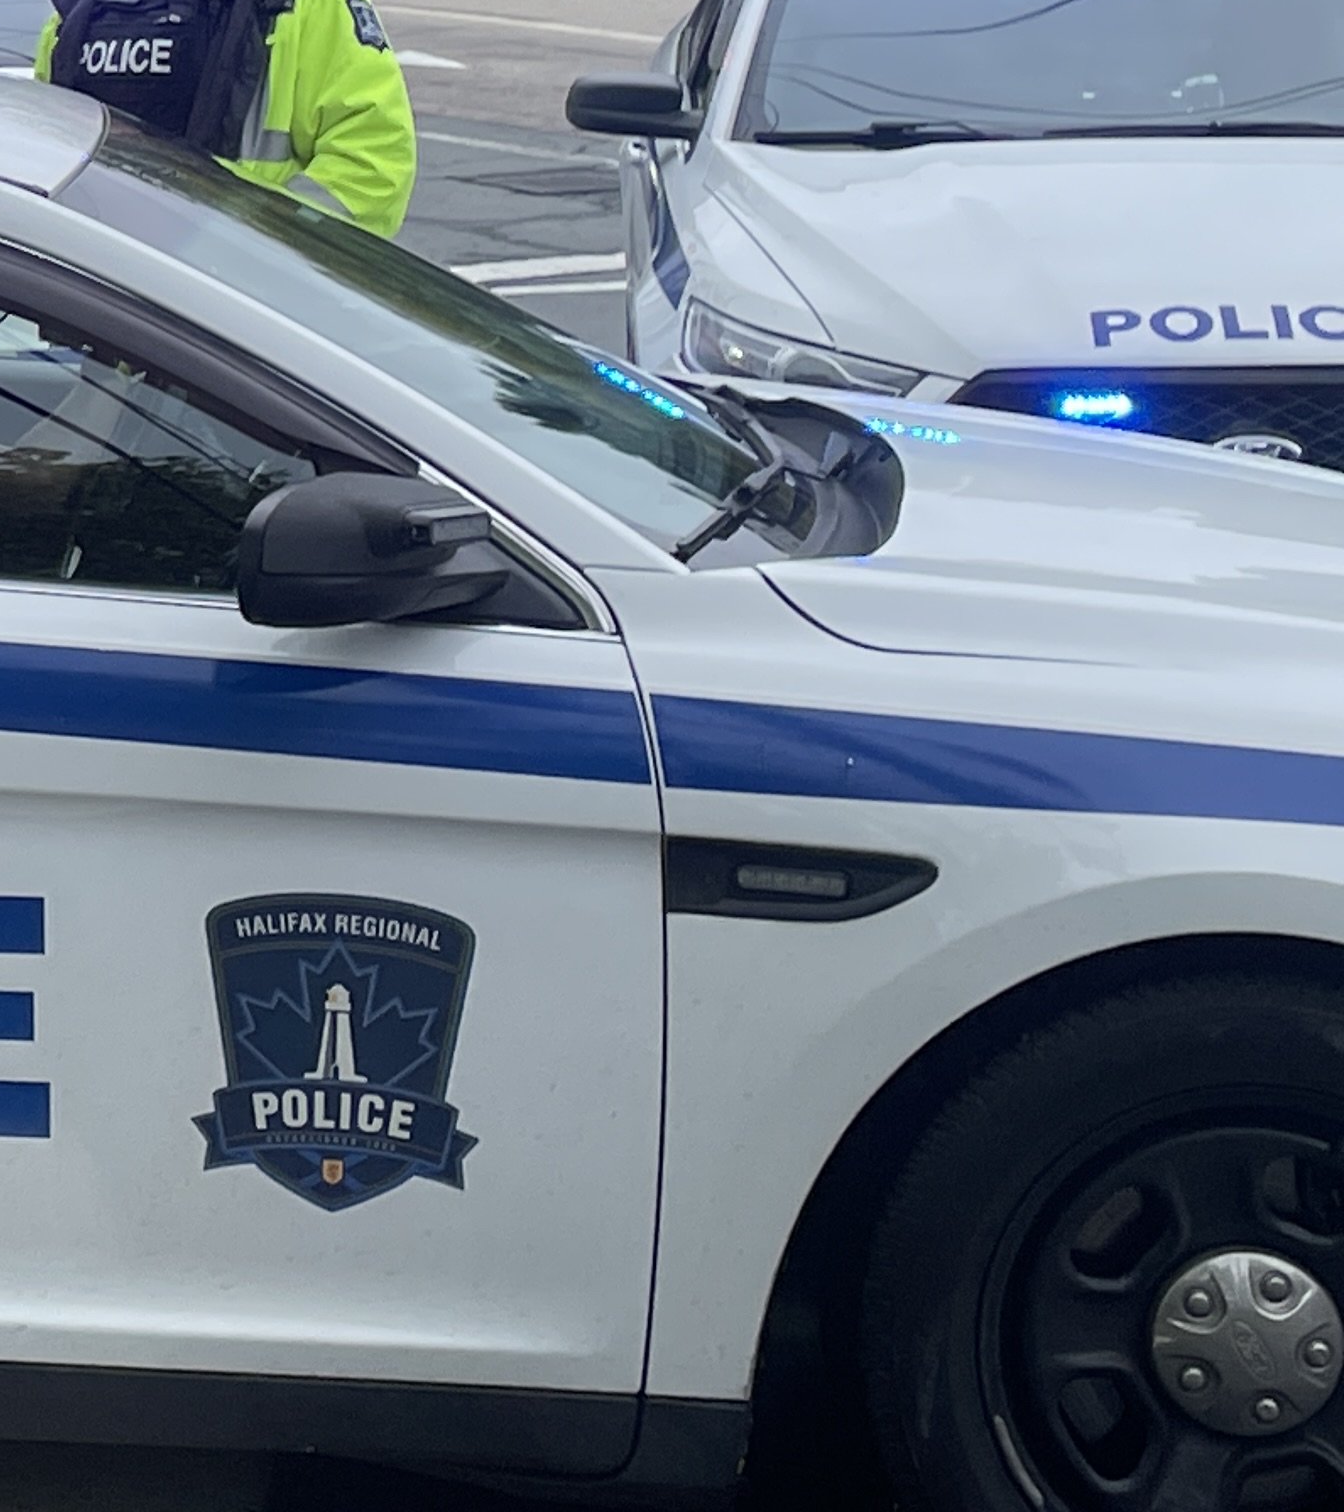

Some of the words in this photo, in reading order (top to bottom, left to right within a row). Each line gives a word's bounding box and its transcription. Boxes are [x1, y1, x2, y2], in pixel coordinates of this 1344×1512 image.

[235, 911, 328, 938] HALIFAX
[334, 913, 442, 951] REGIONAL
[251, 1088, 416, 1140] POLICE
